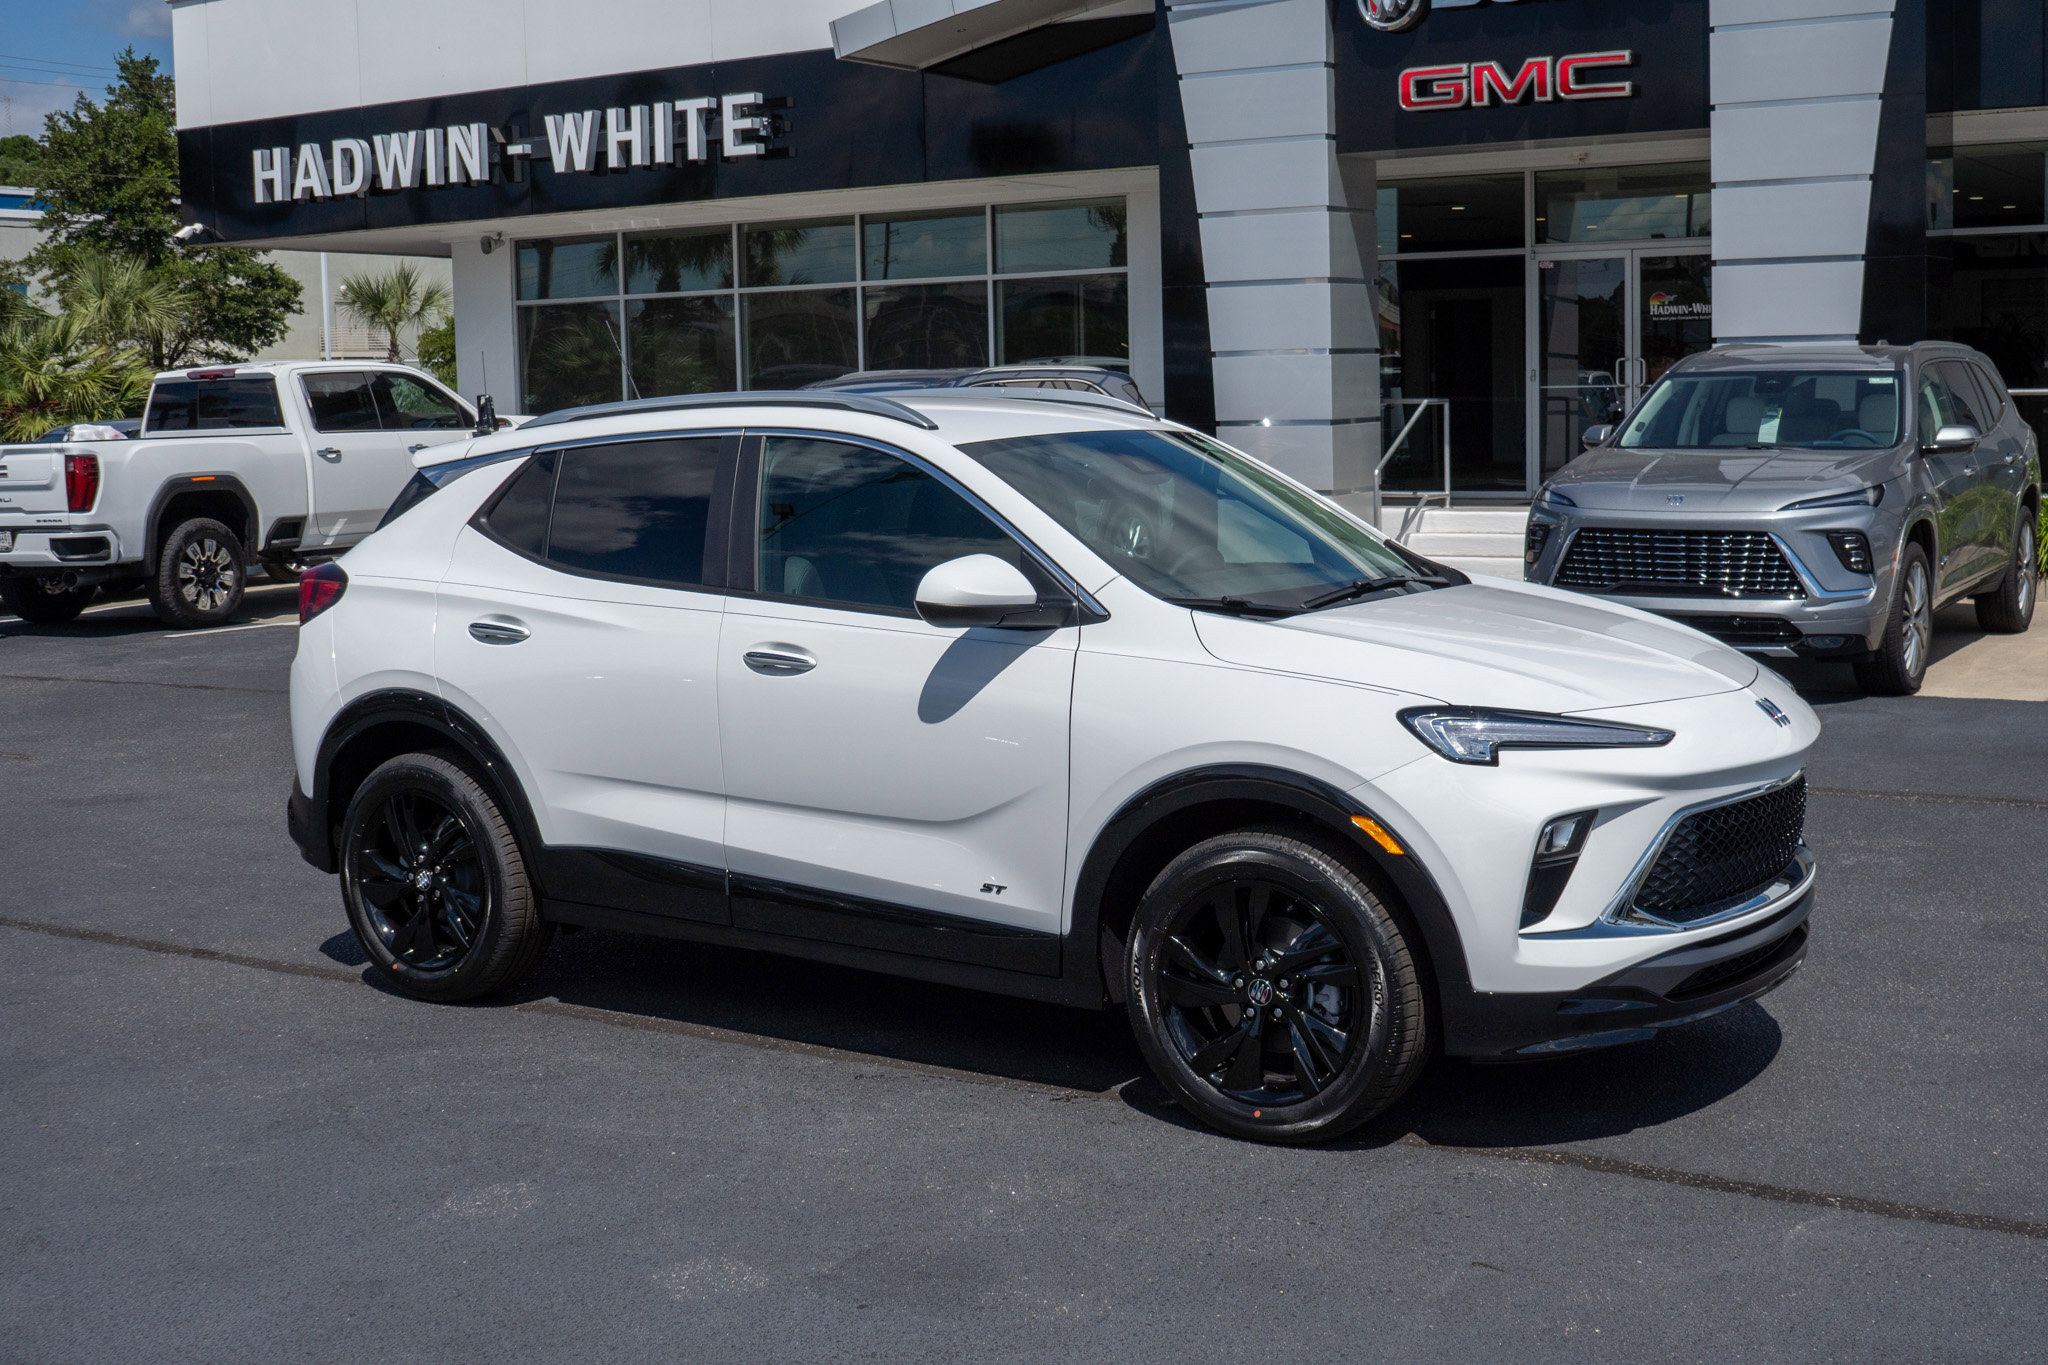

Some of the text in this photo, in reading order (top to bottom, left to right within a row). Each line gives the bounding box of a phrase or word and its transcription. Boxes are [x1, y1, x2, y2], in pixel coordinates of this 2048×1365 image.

[1398, 49, 1633, 112] GMC
[252, 122, 489, 203] HADWIN
[543, 91, 766, 174] WHITE
[1649, 303, 1712, 315] HADWIN-WHI
[979, 883, 1008, 895] ST
